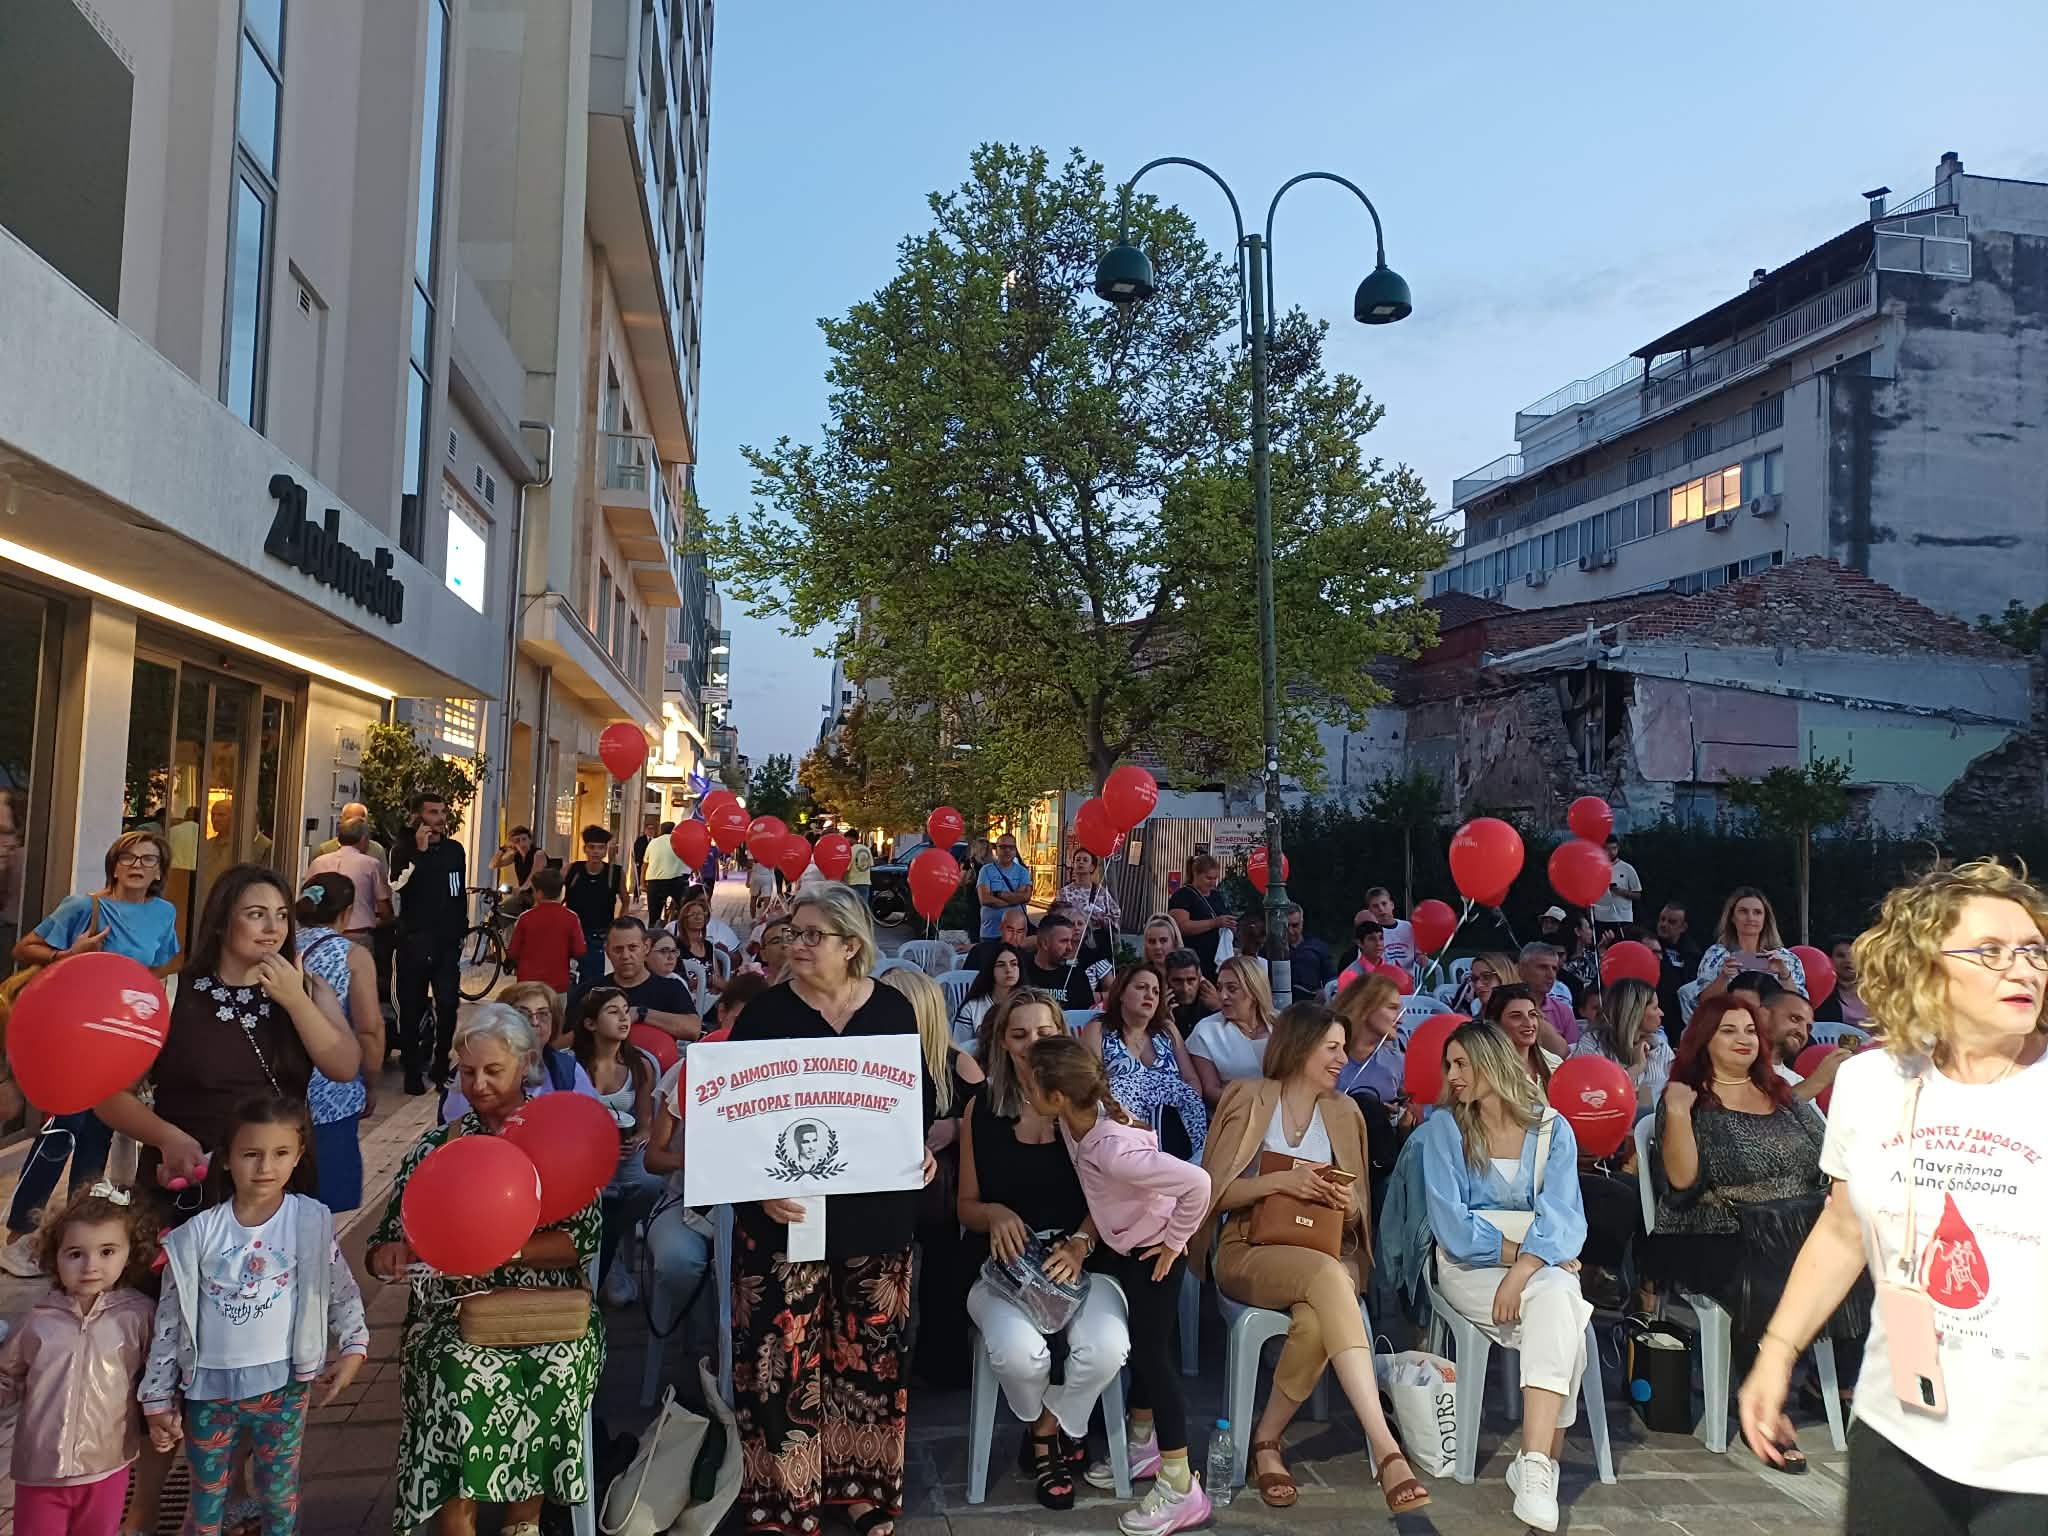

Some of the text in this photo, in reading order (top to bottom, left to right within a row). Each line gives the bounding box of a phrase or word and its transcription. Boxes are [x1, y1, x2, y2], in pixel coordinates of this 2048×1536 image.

[731, 1059, 798, 1089] ΔΗΜΟΤΙΚΟ
[803, 1057, 857, 1073] ΣΧΟΛΕΙΟ
[862, 1061, 916, 1088] ΛΑΡΙΣΑΣ
[1881, 1126, 1960, 1150] ΟΝΤΕΣ
[1890, 1170, 2018, 1195] Λμπδηδρομια
[1436, 1392, 1457, 1468] YOURS
